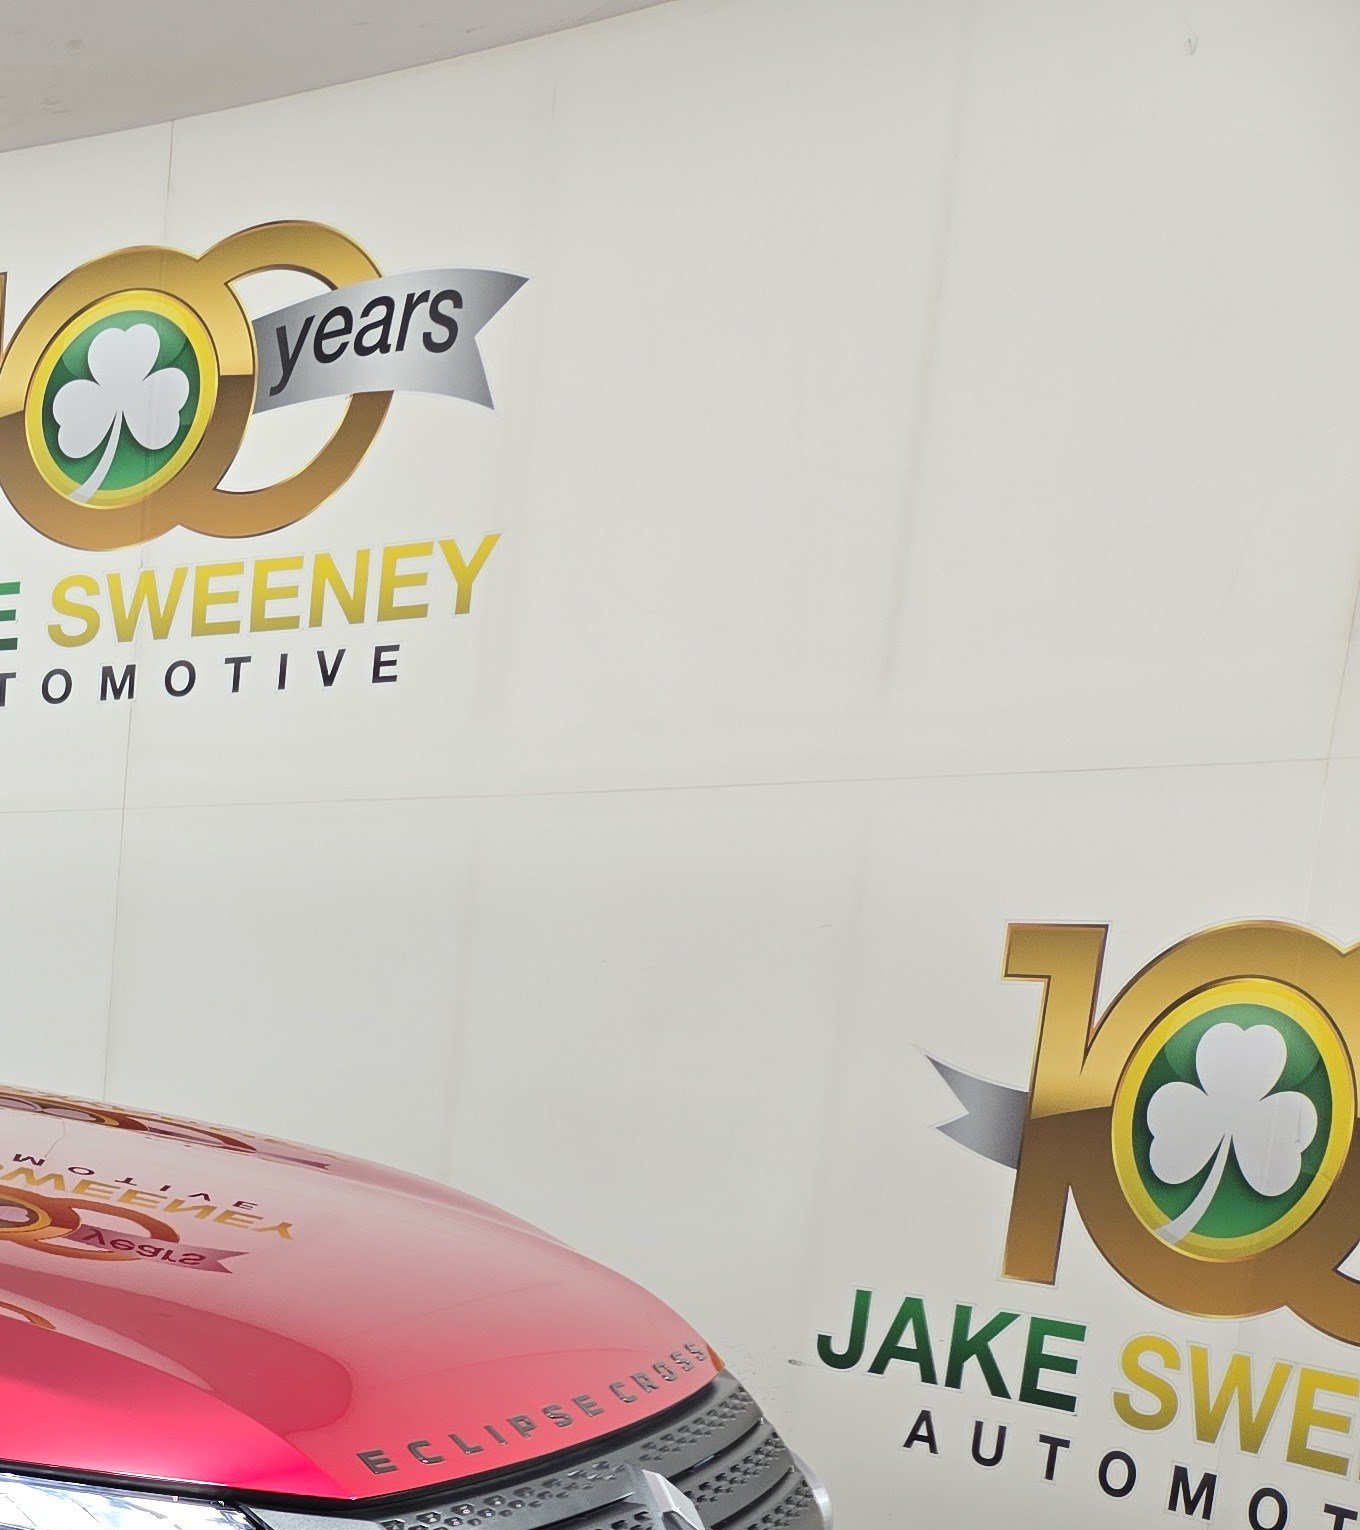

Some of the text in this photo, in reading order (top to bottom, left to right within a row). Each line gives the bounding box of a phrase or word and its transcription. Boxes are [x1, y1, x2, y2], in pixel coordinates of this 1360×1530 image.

[269, 287, 464, 397] years
[47, 532, 502, 649] SWEENEY
[1001, 920, 1360, 1347] 10
[355, 1342, 708, 1476] ECLIPSE CROSS
[816, 1289, 1360, 1481] JAKE SWE
